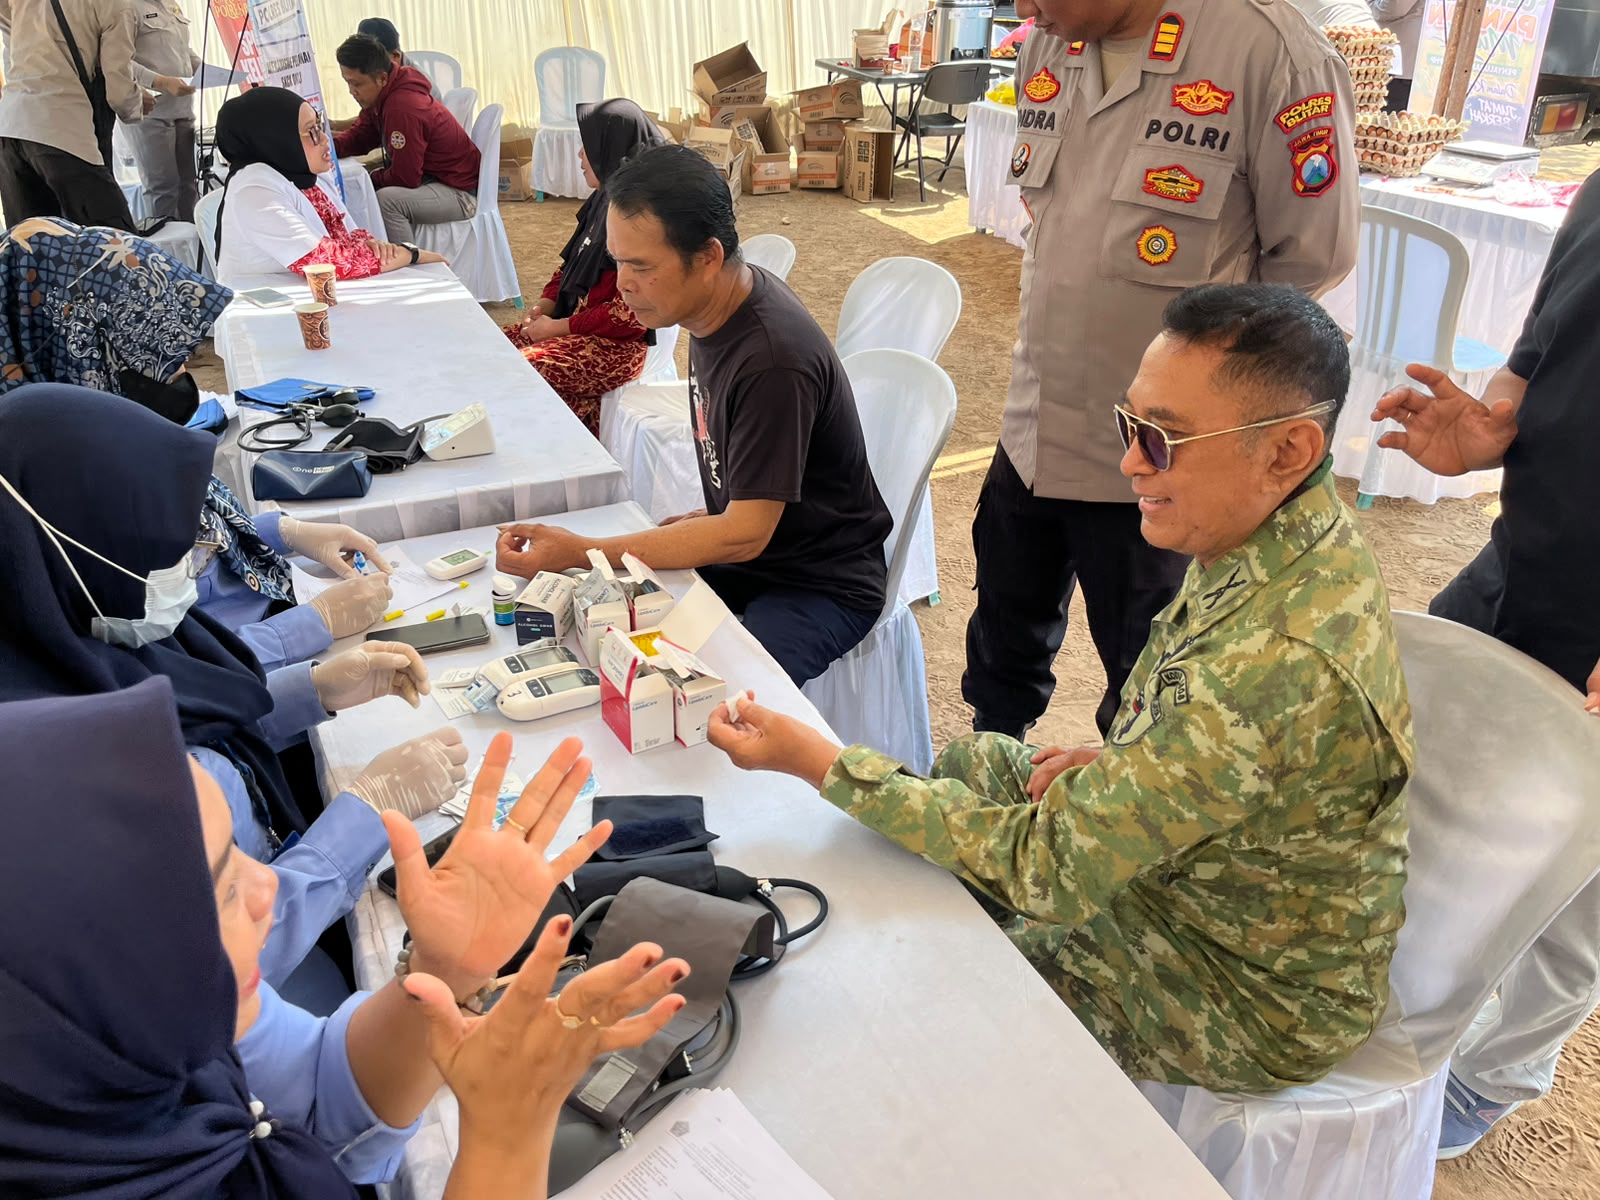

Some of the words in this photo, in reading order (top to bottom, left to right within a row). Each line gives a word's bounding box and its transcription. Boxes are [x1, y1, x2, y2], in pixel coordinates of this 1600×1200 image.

[1280, 96, 1332, 125] POLRES
[1286, 105, 1329, 128] BLITAR
[1145, 119, 1230, 152] POLRI
